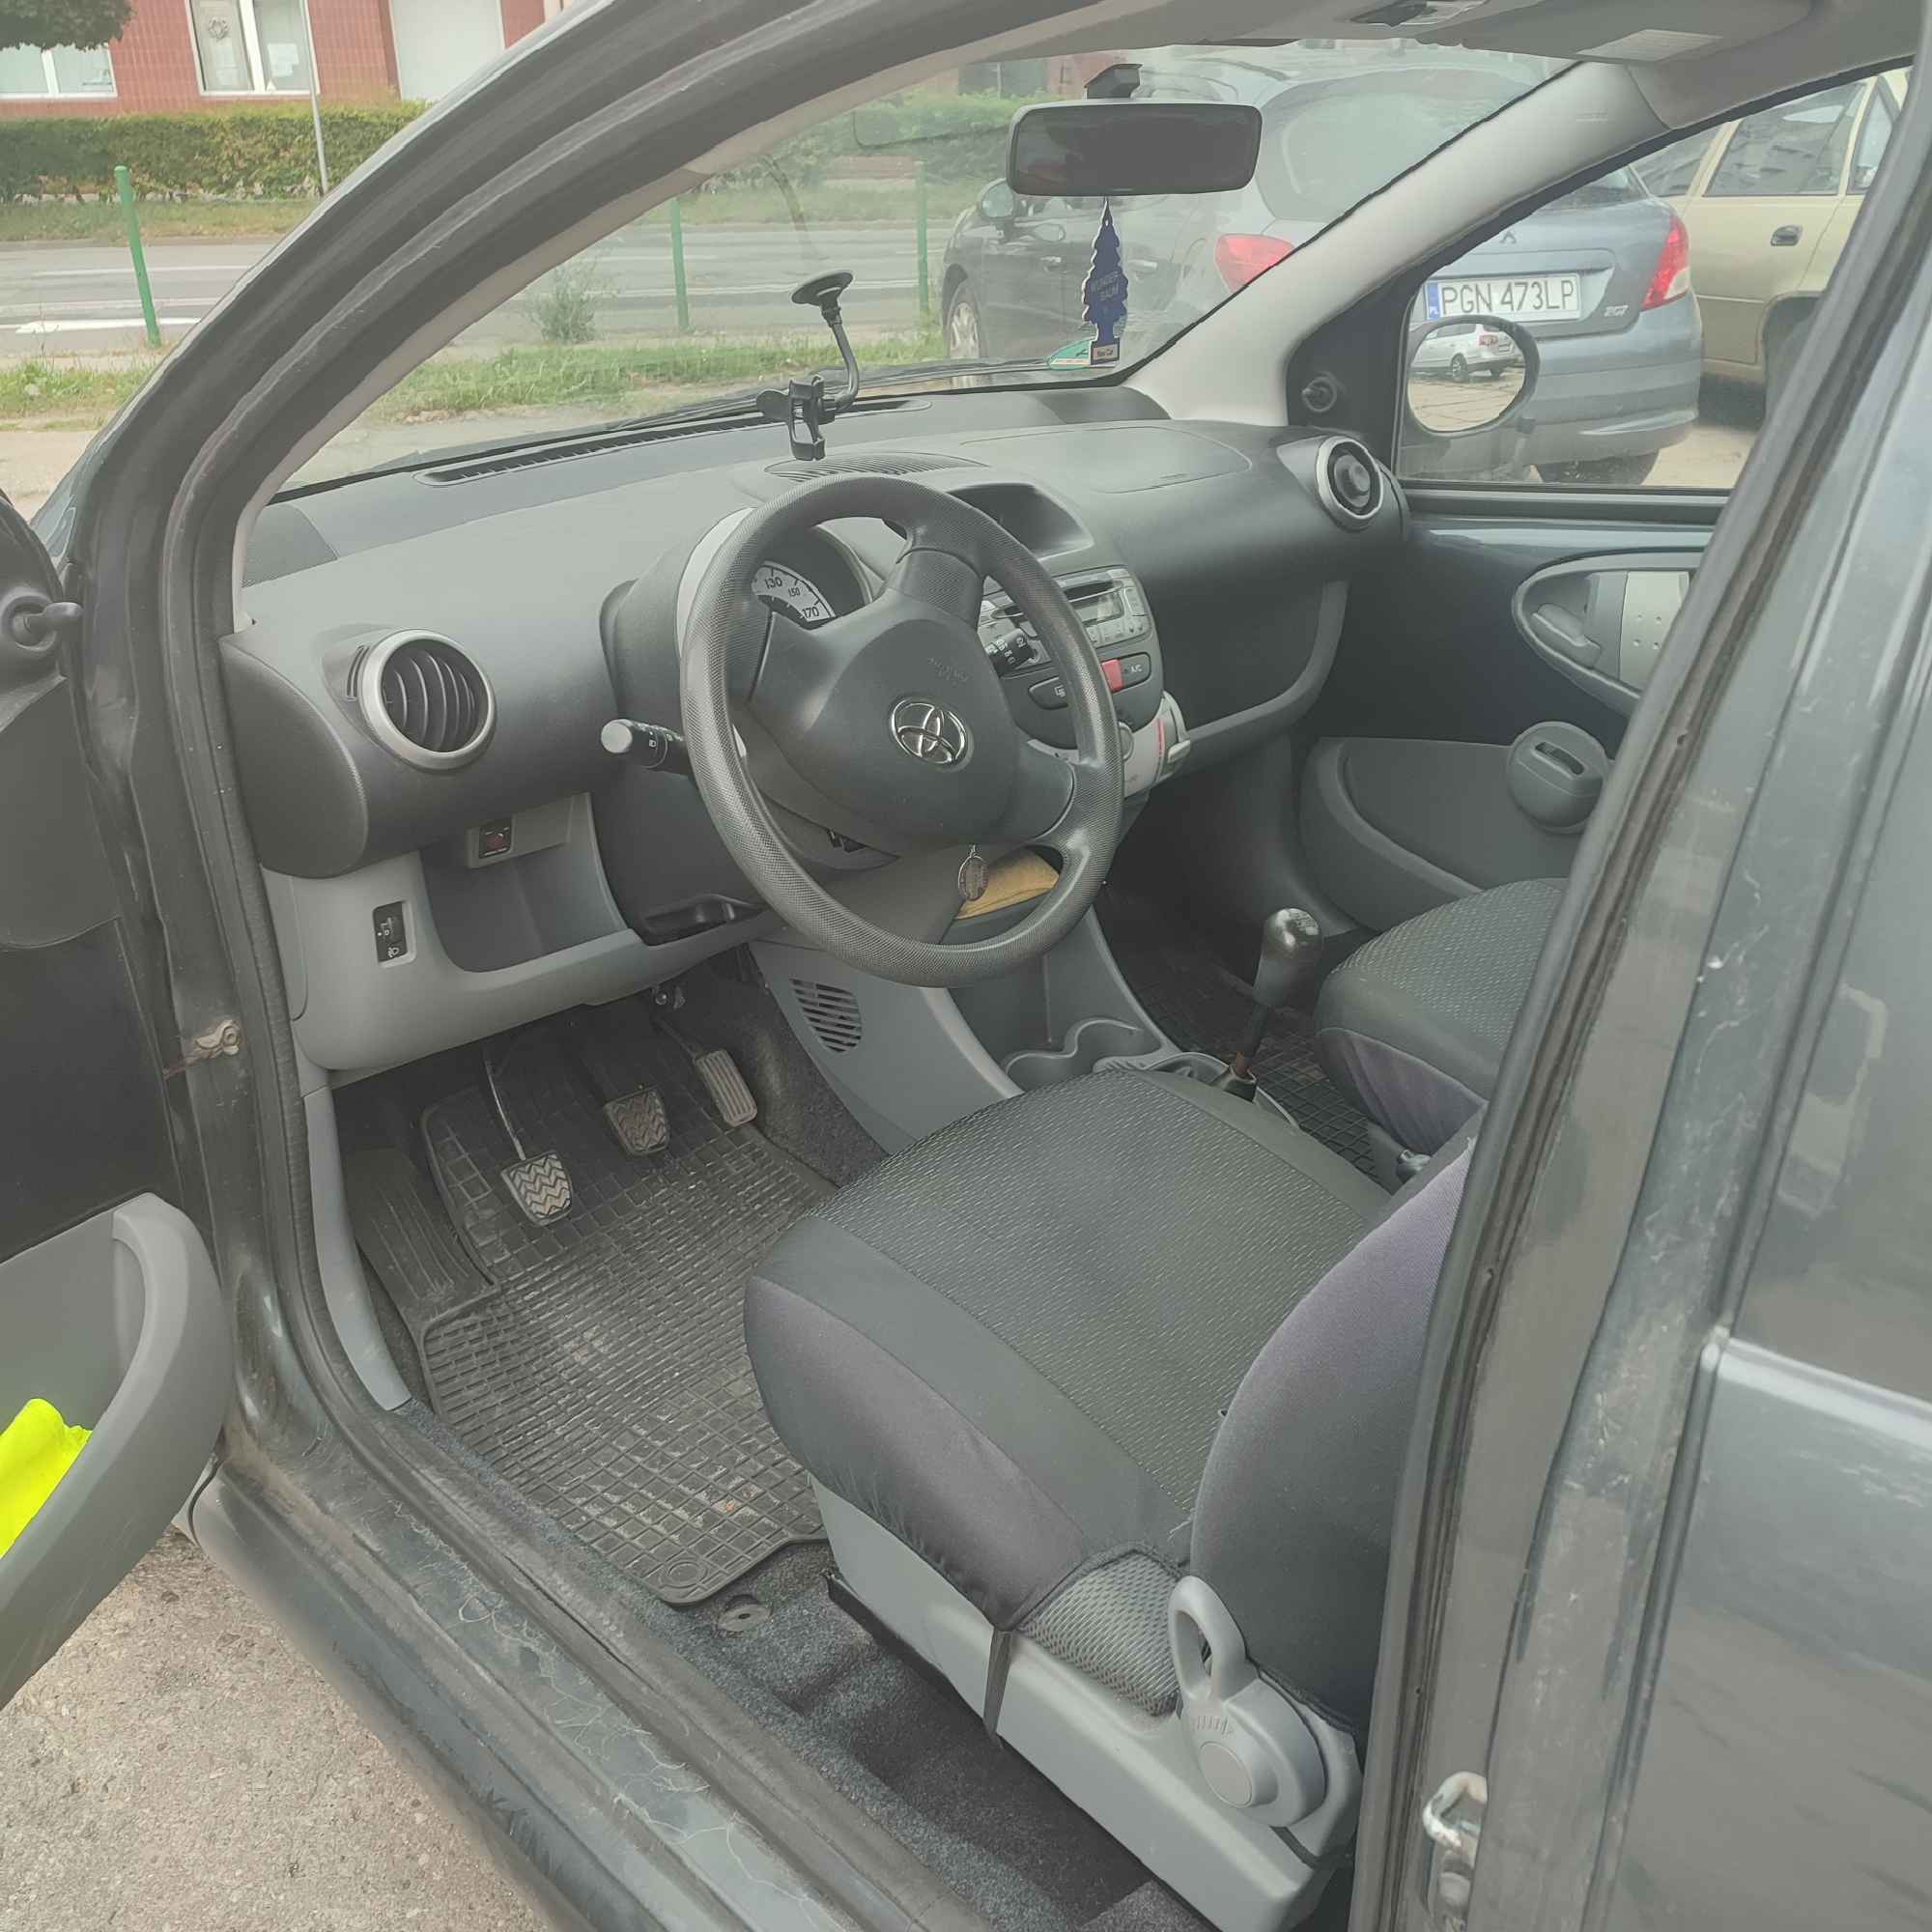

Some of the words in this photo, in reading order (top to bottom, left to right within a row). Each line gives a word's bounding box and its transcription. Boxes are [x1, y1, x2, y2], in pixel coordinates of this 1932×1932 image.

[1440, 285, 1492, 315] PGN
[1500, 278, 1575, 311] 473LP
[764, 576, 783, 590] 130
[787, 585, 801, 598] 150
[802, 606, 820, 619] 170
